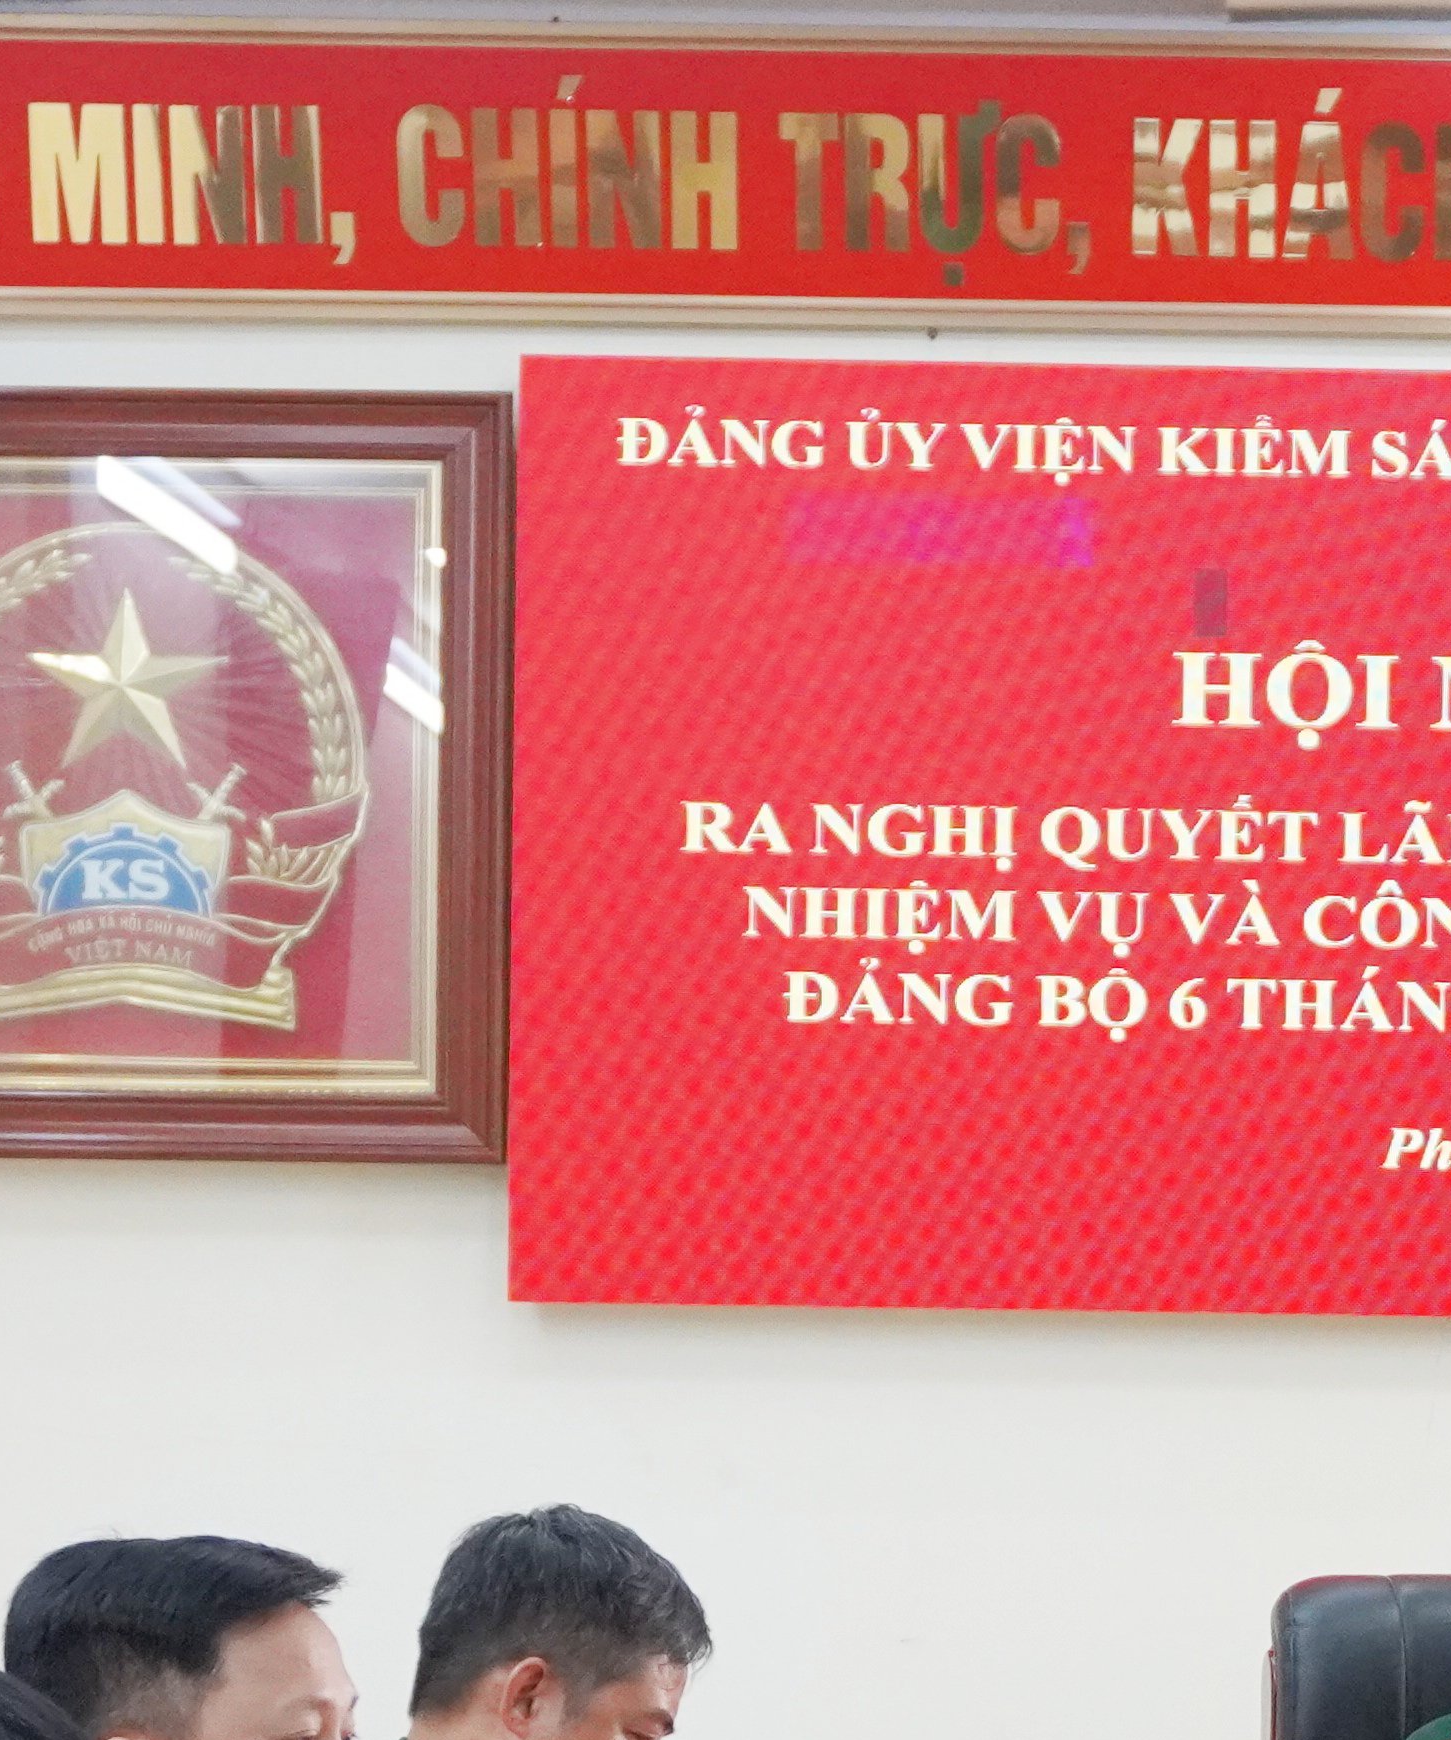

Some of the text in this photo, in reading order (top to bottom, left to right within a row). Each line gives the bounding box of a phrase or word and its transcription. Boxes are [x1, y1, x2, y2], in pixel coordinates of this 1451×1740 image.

[27, 101, 356, 265] MINH,
[396, 75, 738, 250] CHÍNH
[779, 98, 1091, 286] TRỰC,
[616, 404, 825, 469] ĐẢNG
[844, 407, 947, 472] ỦY
[959, 416, 1137, 487] VIỆN
[1157, 414, 1352, 479] KIỂM
[1171, 639, 1400, 751] HỘI
[679, 800, 793, 855] RA
[808, 803, 1018, 873] NGHỊ
[1040, 794, 1319, 872] QUYẾT
[81, 858, 171, 900] KS
[741, 879, 1018, 955] NHIỆM
[1036, 890, 1150, 959] VỤ
[1169, 879, 1281, 947] VÀ
[782, 956, 1014, 1028] ĐẢNG
[1035, 967, 1149, 1043] BỘ
[1168, 977, 1209, 1031] 6
